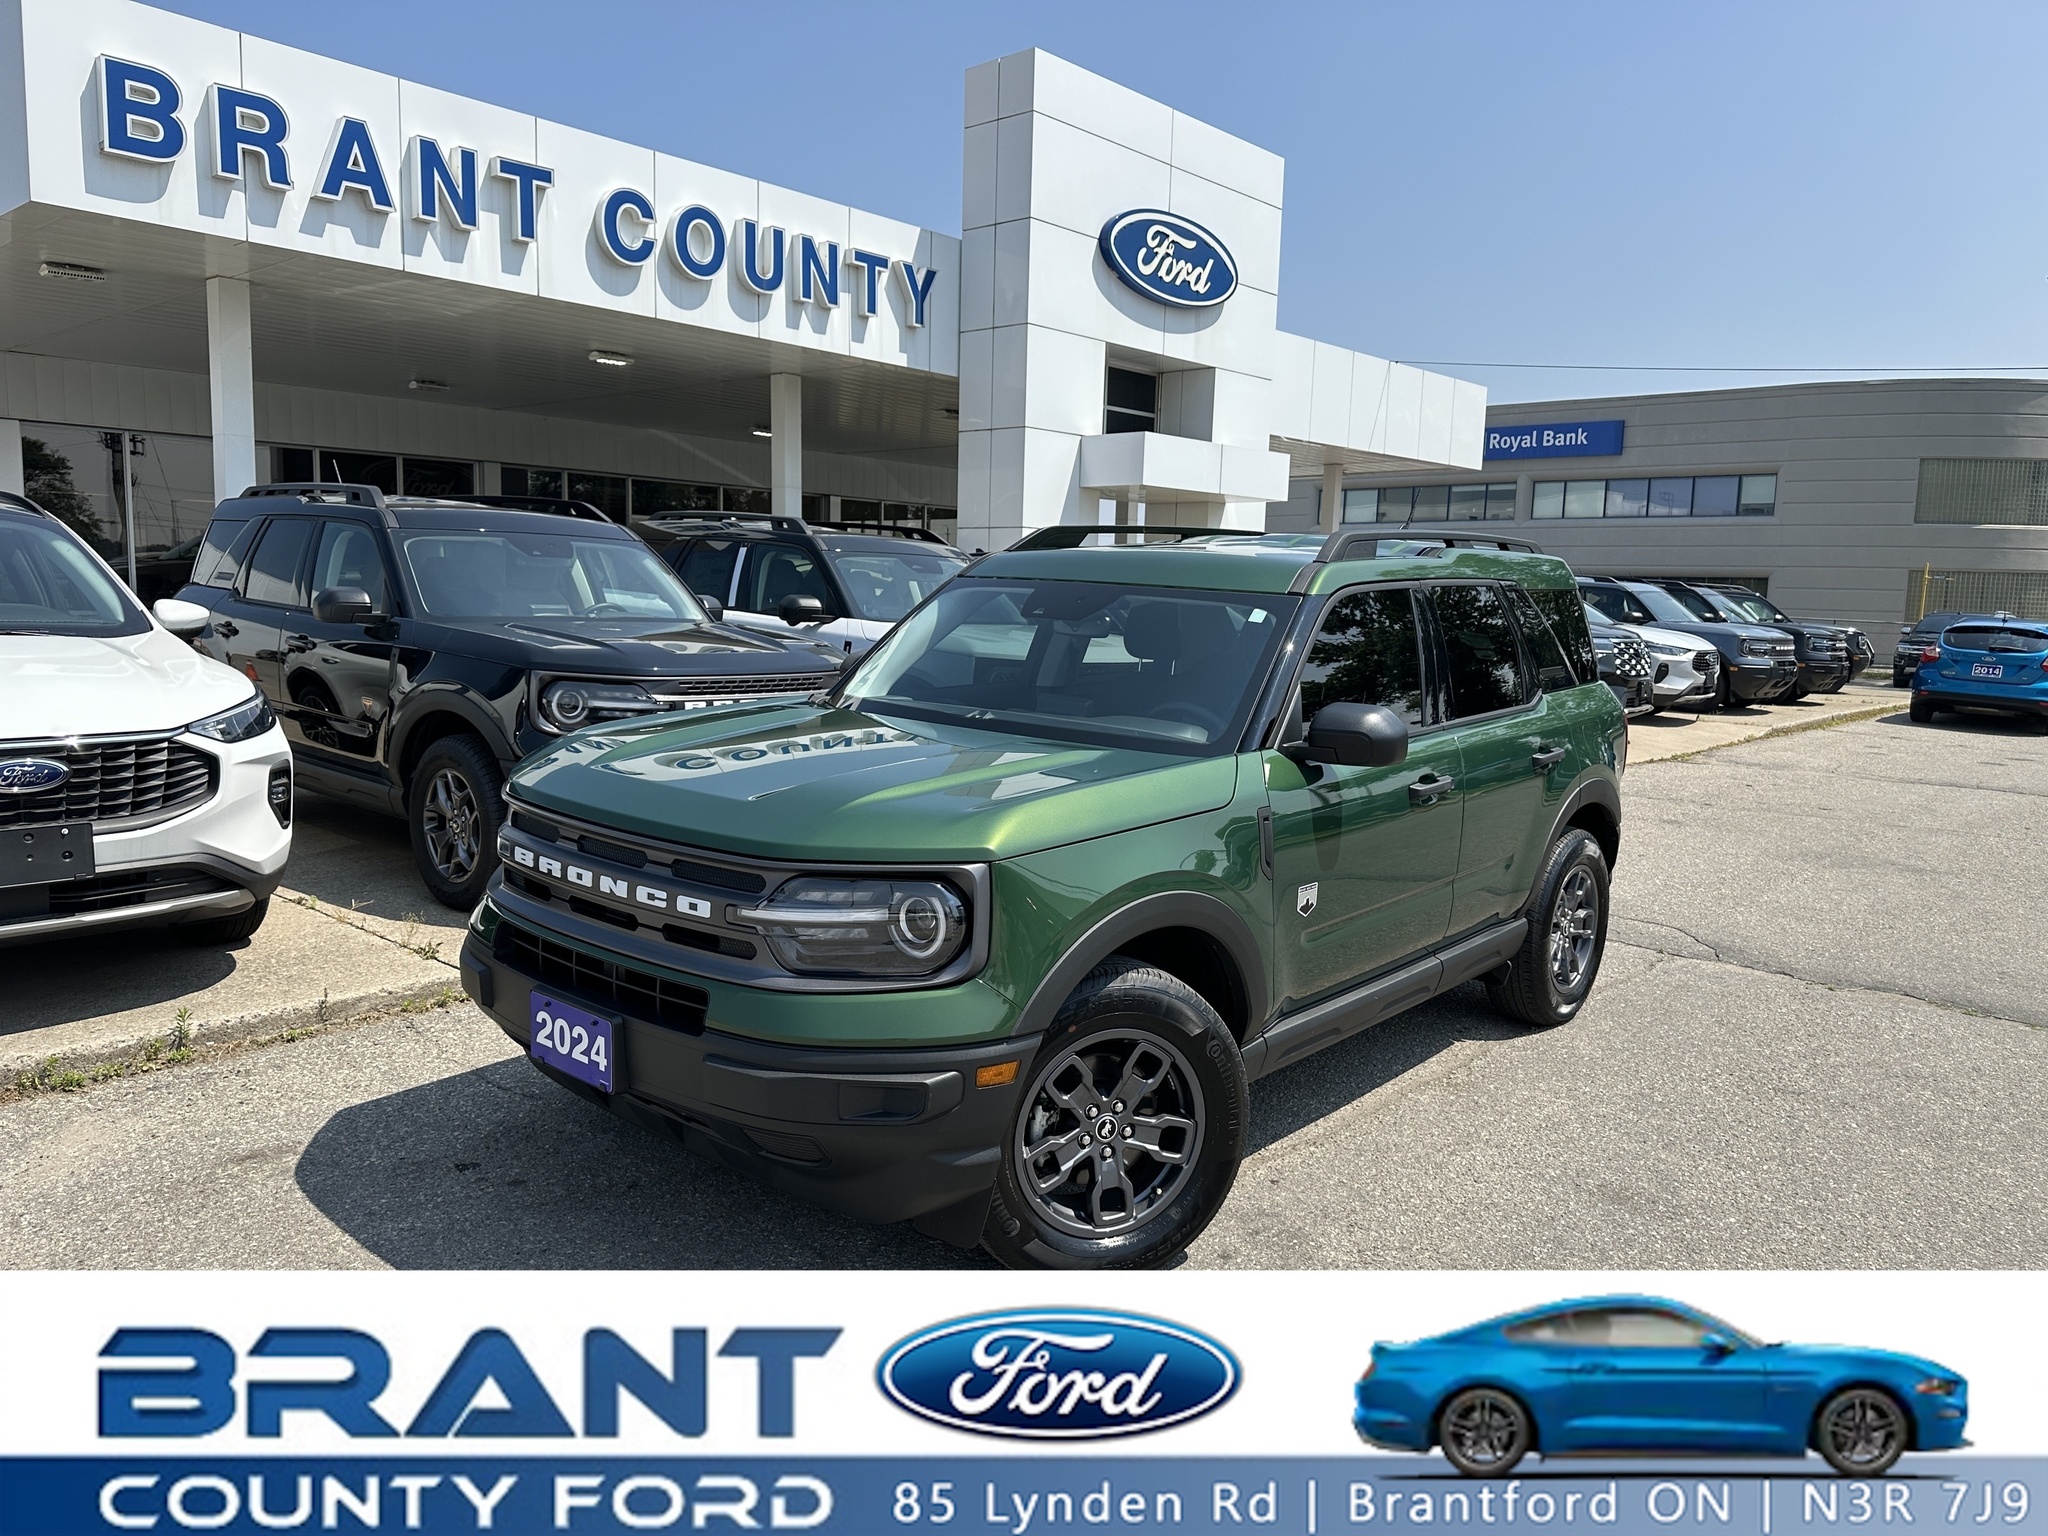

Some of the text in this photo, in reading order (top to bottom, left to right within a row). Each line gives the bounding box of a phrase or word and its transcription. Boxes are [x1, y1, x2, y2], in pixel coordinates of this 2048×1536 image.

[96, 54, 939, 328] BRANT COUNTY
[1137, 224, 1214, 294] Ford
[1489, 427, 1588, 453] Royal Bank
[1974, 666, 2000, 675] 2014
[0, 766, 48, 786] Ford
[514, 846, 711, 918] BRONCO
[536, 1010, 607, 1072] 2024
